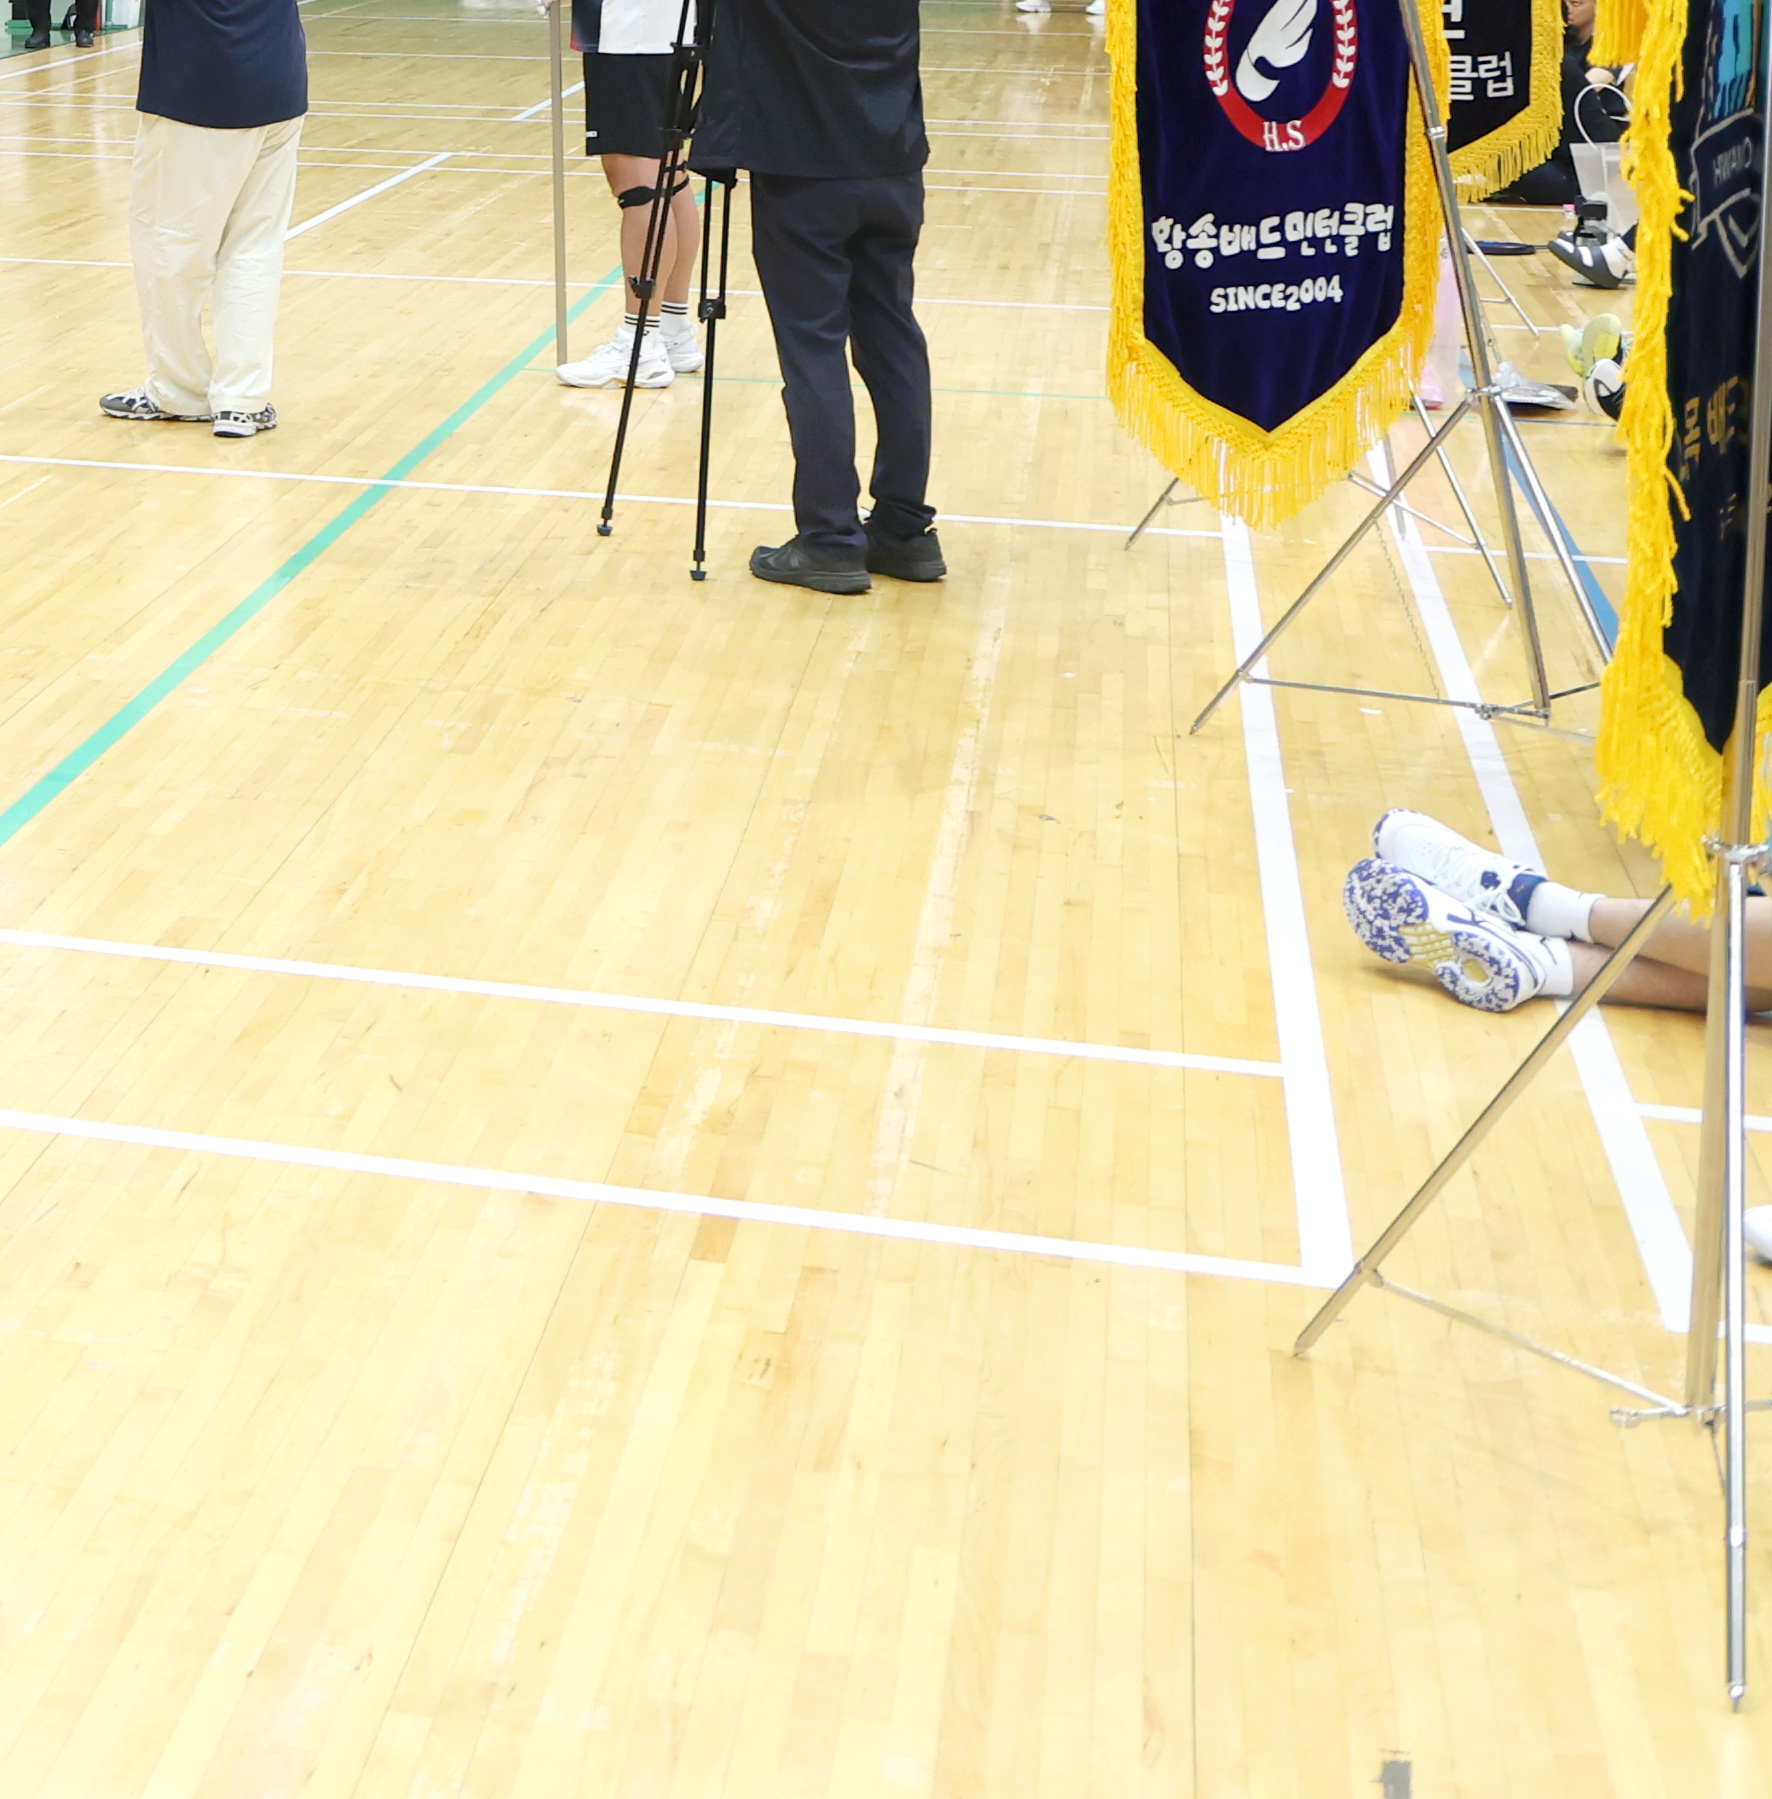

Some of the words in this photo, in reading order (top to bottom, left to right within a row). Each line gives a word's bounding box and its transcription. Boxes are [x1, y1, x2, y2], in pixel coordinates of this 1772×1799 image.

[1262, 119, 1306, 152] H.S
[1151, 202, 1395, 270] 황송배드민턴클럽
[1209, 274, 1344, 313] SINCE2004
